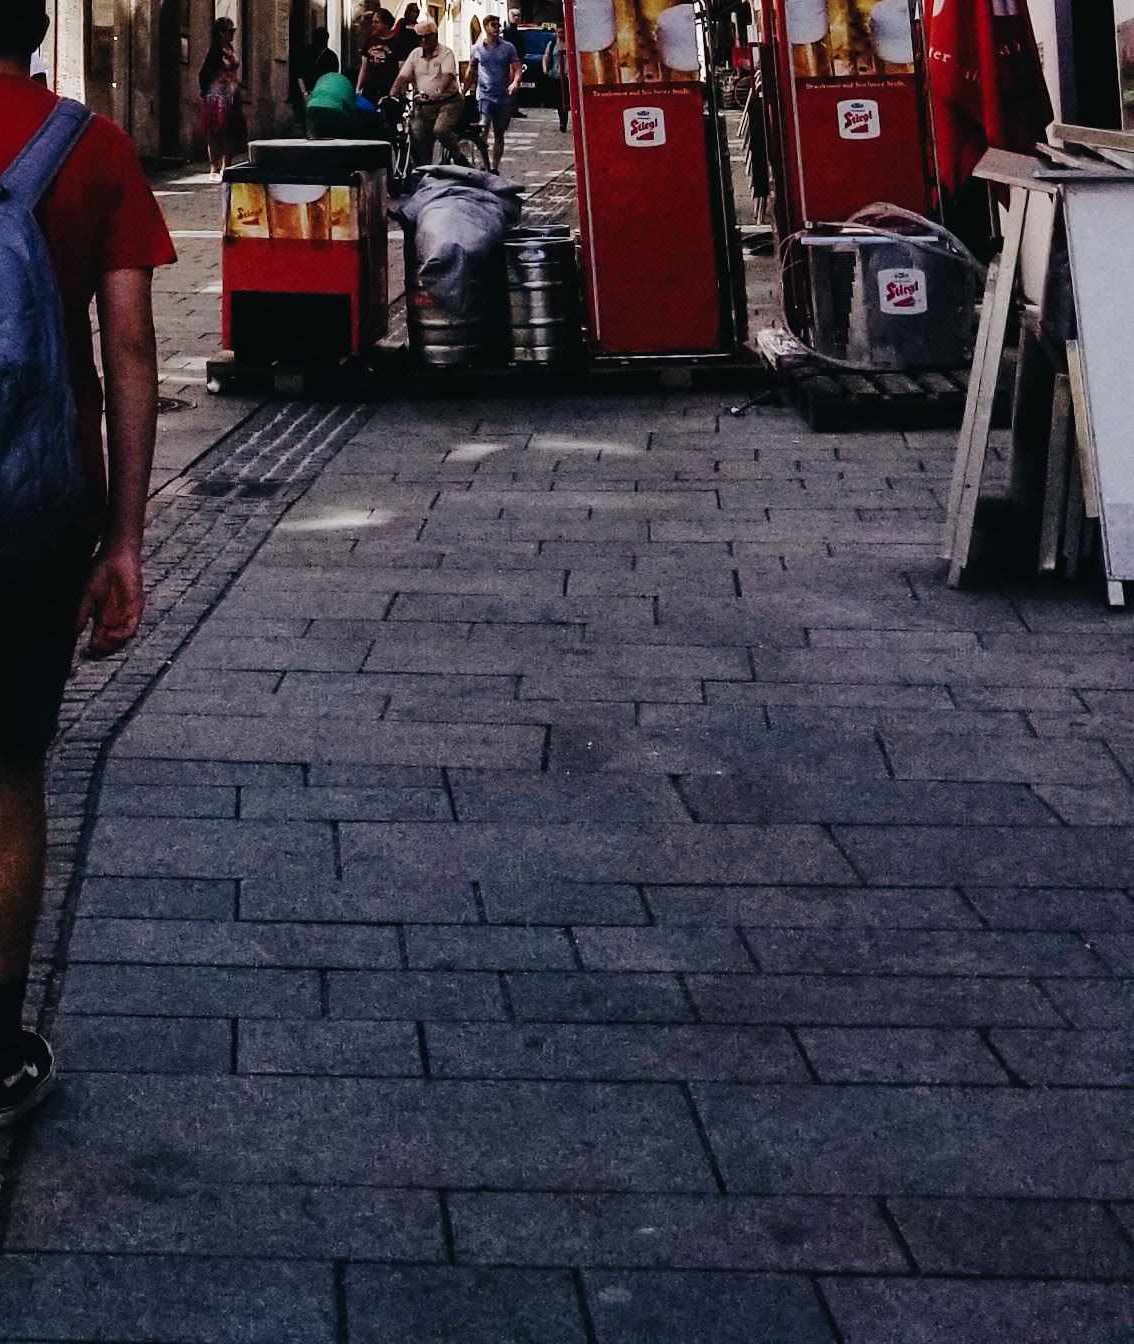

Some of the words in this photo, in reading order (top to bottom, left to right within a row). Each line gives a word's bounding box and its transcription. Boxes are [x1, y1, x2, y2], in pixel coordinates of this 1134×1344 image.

[630, 118, 658, 137] Stiegl
[844, 110, 873, 129] Stiegl
[886, 280, 919, 302] Stiegl
